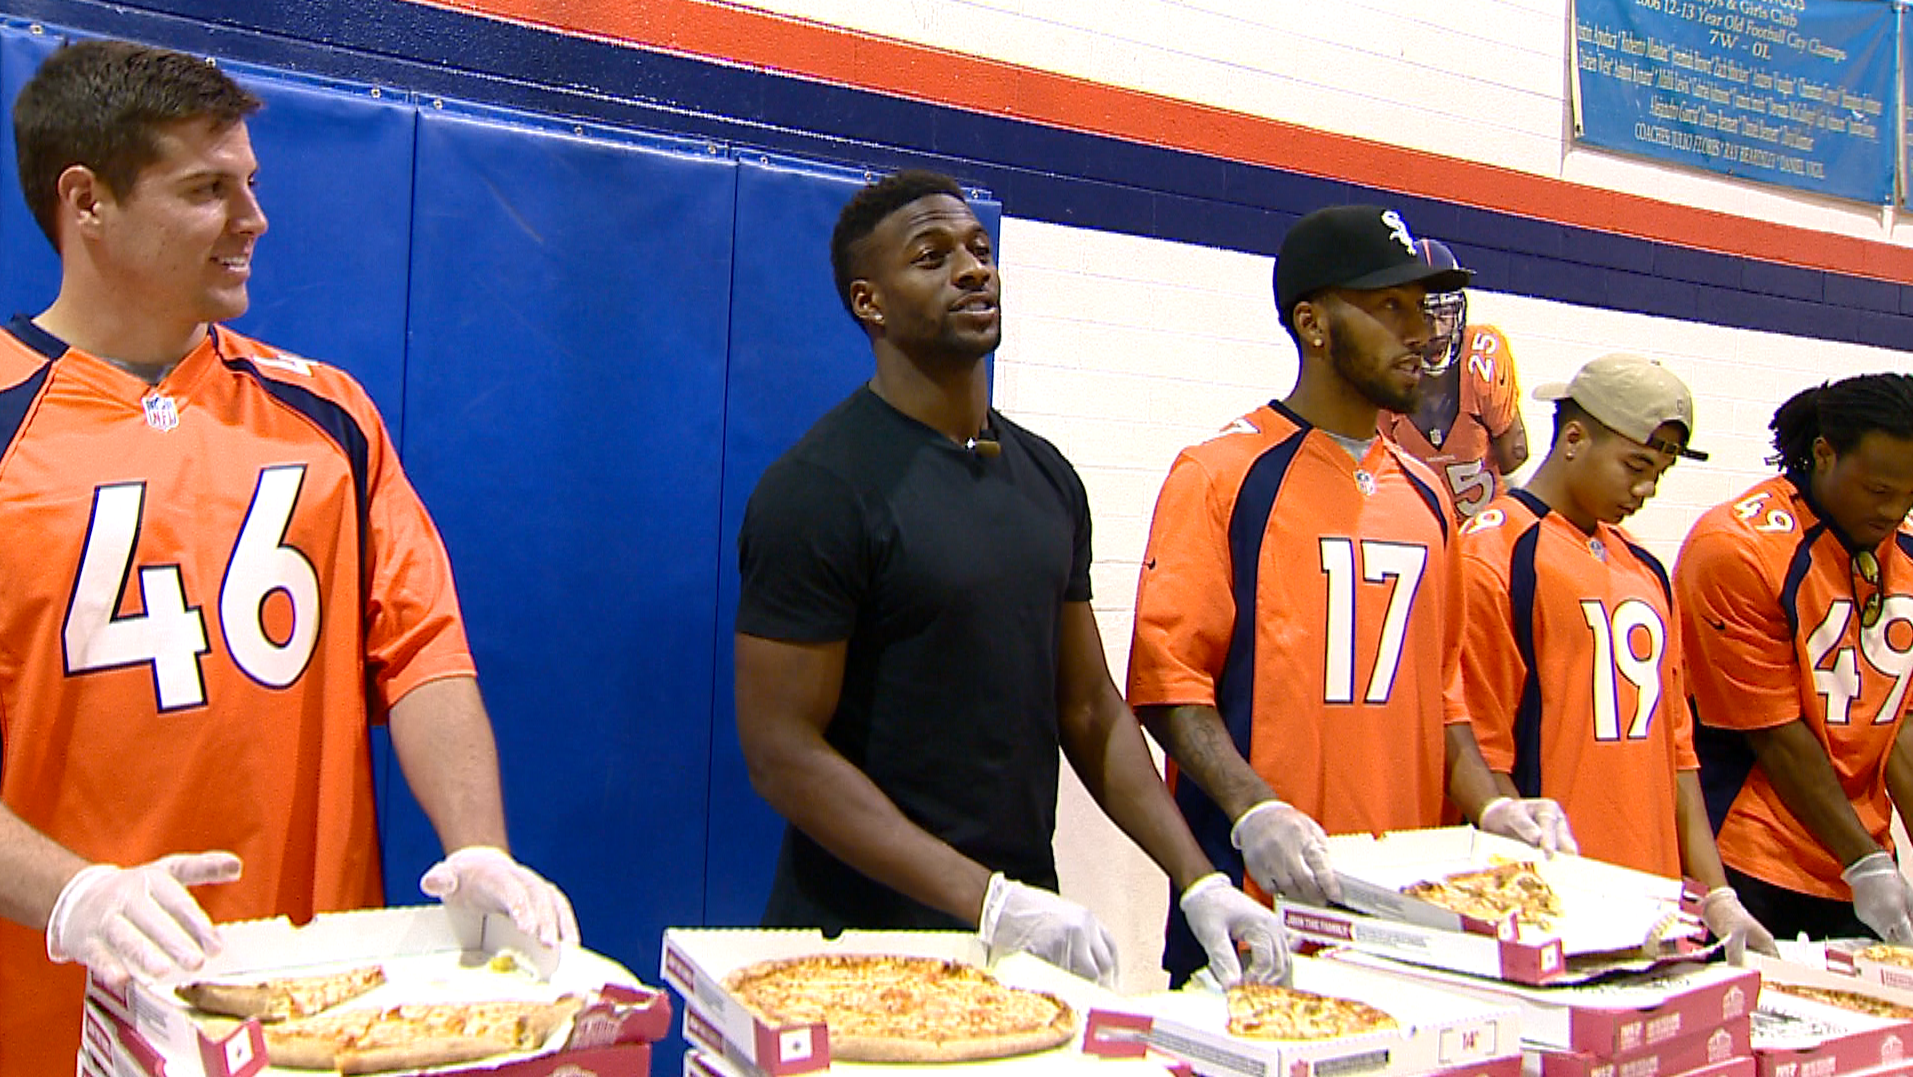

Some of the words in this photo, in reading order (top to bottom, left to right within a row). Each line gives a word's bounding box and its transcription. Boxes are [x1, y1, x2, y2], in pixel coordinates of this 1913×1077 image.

[1698, 6, 1723, 26] Year
[1724, 15, 1744, 32] Old
[1746, 20, 1787, 44] Football
[1787, 32, 1807, 54] City
[1709, 29, 1739, 49] 7W
[1771, 8, 1798, 28] Club
[1733, 491, 1796, 534] 49
[62, 463, 322, 713] 46
[1318, 537, 1428, 705] 17
[1579, 598, 1667, 742] 19
[1806, 594, 1913, 726] 49
